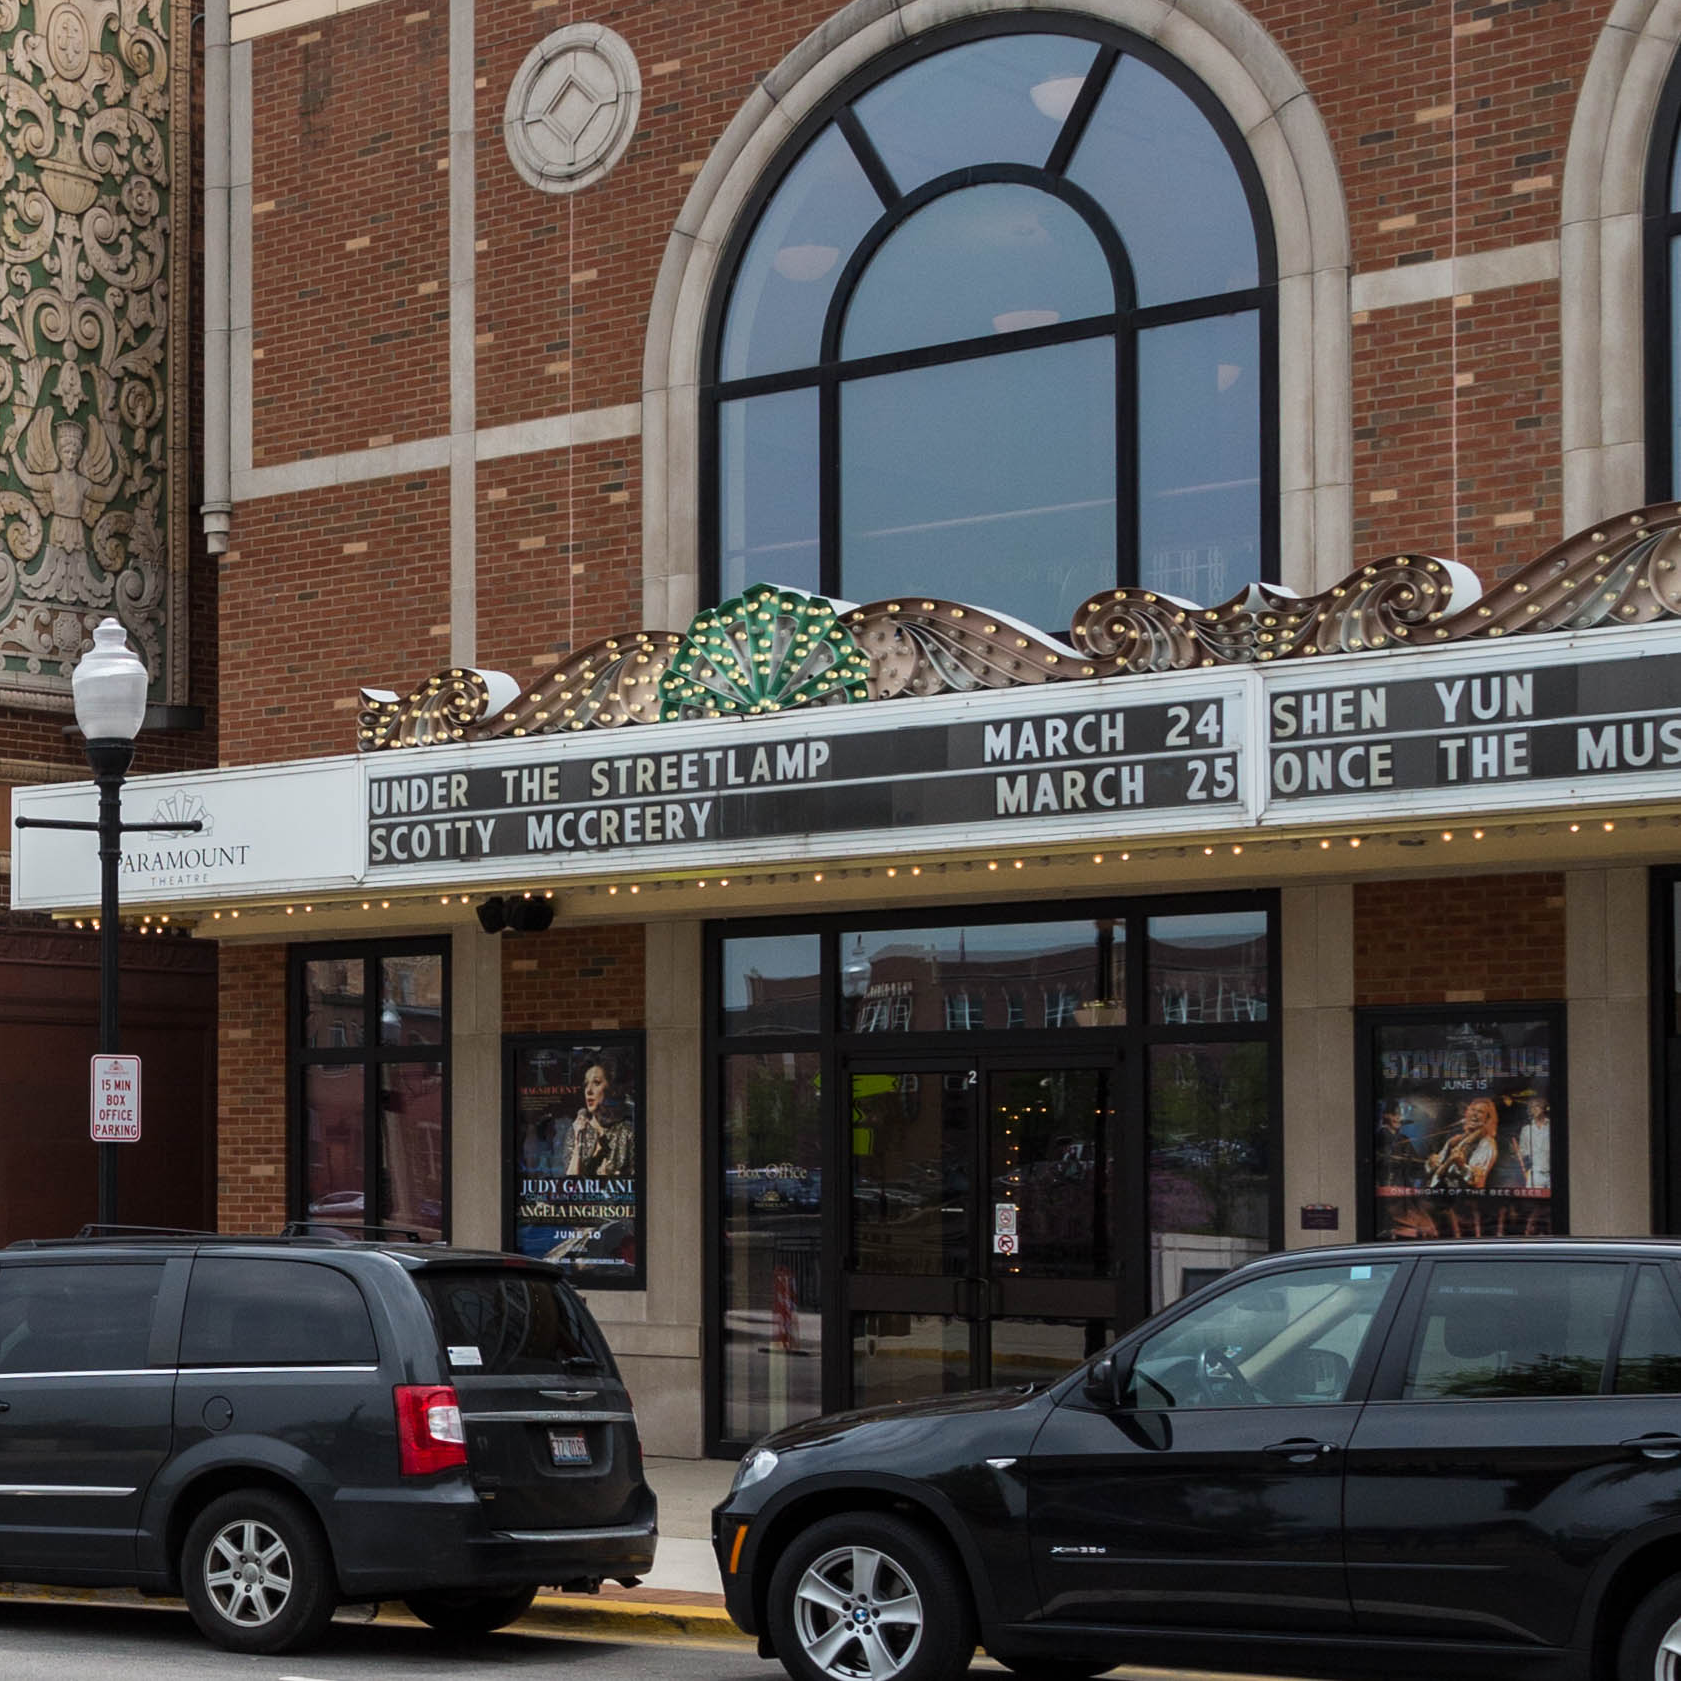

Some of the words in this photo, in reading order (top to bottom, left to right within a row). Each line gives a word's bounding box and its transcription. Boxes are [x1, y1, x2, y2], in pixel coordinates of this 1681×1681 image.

[1272, 687, 1386, 738] SHEN
[1435, 673, 1533, 724] YUN
[371, 774, 469, 815] UNDER
[502, 766, 559, 803] THE
[591, 741, 829, 797] STREETLAMP
[984, 712, 1123, 762] MARCH
[1167, 704, 1221, 747] 24
[1274, 745, 1393, 794] ONCE
[1439, 732, 1529, 781] THE
[371, 819, 495, 860] SCOTTY
[527, 801, 712, 851] MCCREERY
[996, 765, 1145, 814] MARCH
[1187, 757, 1236, 800] 25
[151, 873, 209, 887] THEATRE
[968, 1070, 977, 1084] 2
[101, 1079, 111, 1091] 15
[114, 1080, 131, 1091] MIN
[1441, 1079, 1472, 1090] JUNE
[106, 1094, 126, 1106] BOX
[99, 1109, 133, 1121] OFFICE
[94, 1124, 137, 1136] PARKING
[765, 1162, 807, 1179] Office
[520, 1179, 558, 1195] JUDY
[1390, 1188, 1413, 1196] ONE
[1414, 1188, 1445, 1196] NIGHT
[1467, 1187, 1486, 1196] THE
[519, 1204, 567, 1218] ANGELA
[553, 1230, 583, 1239] JUNE
[588, 1231, 602, 1240] 10
